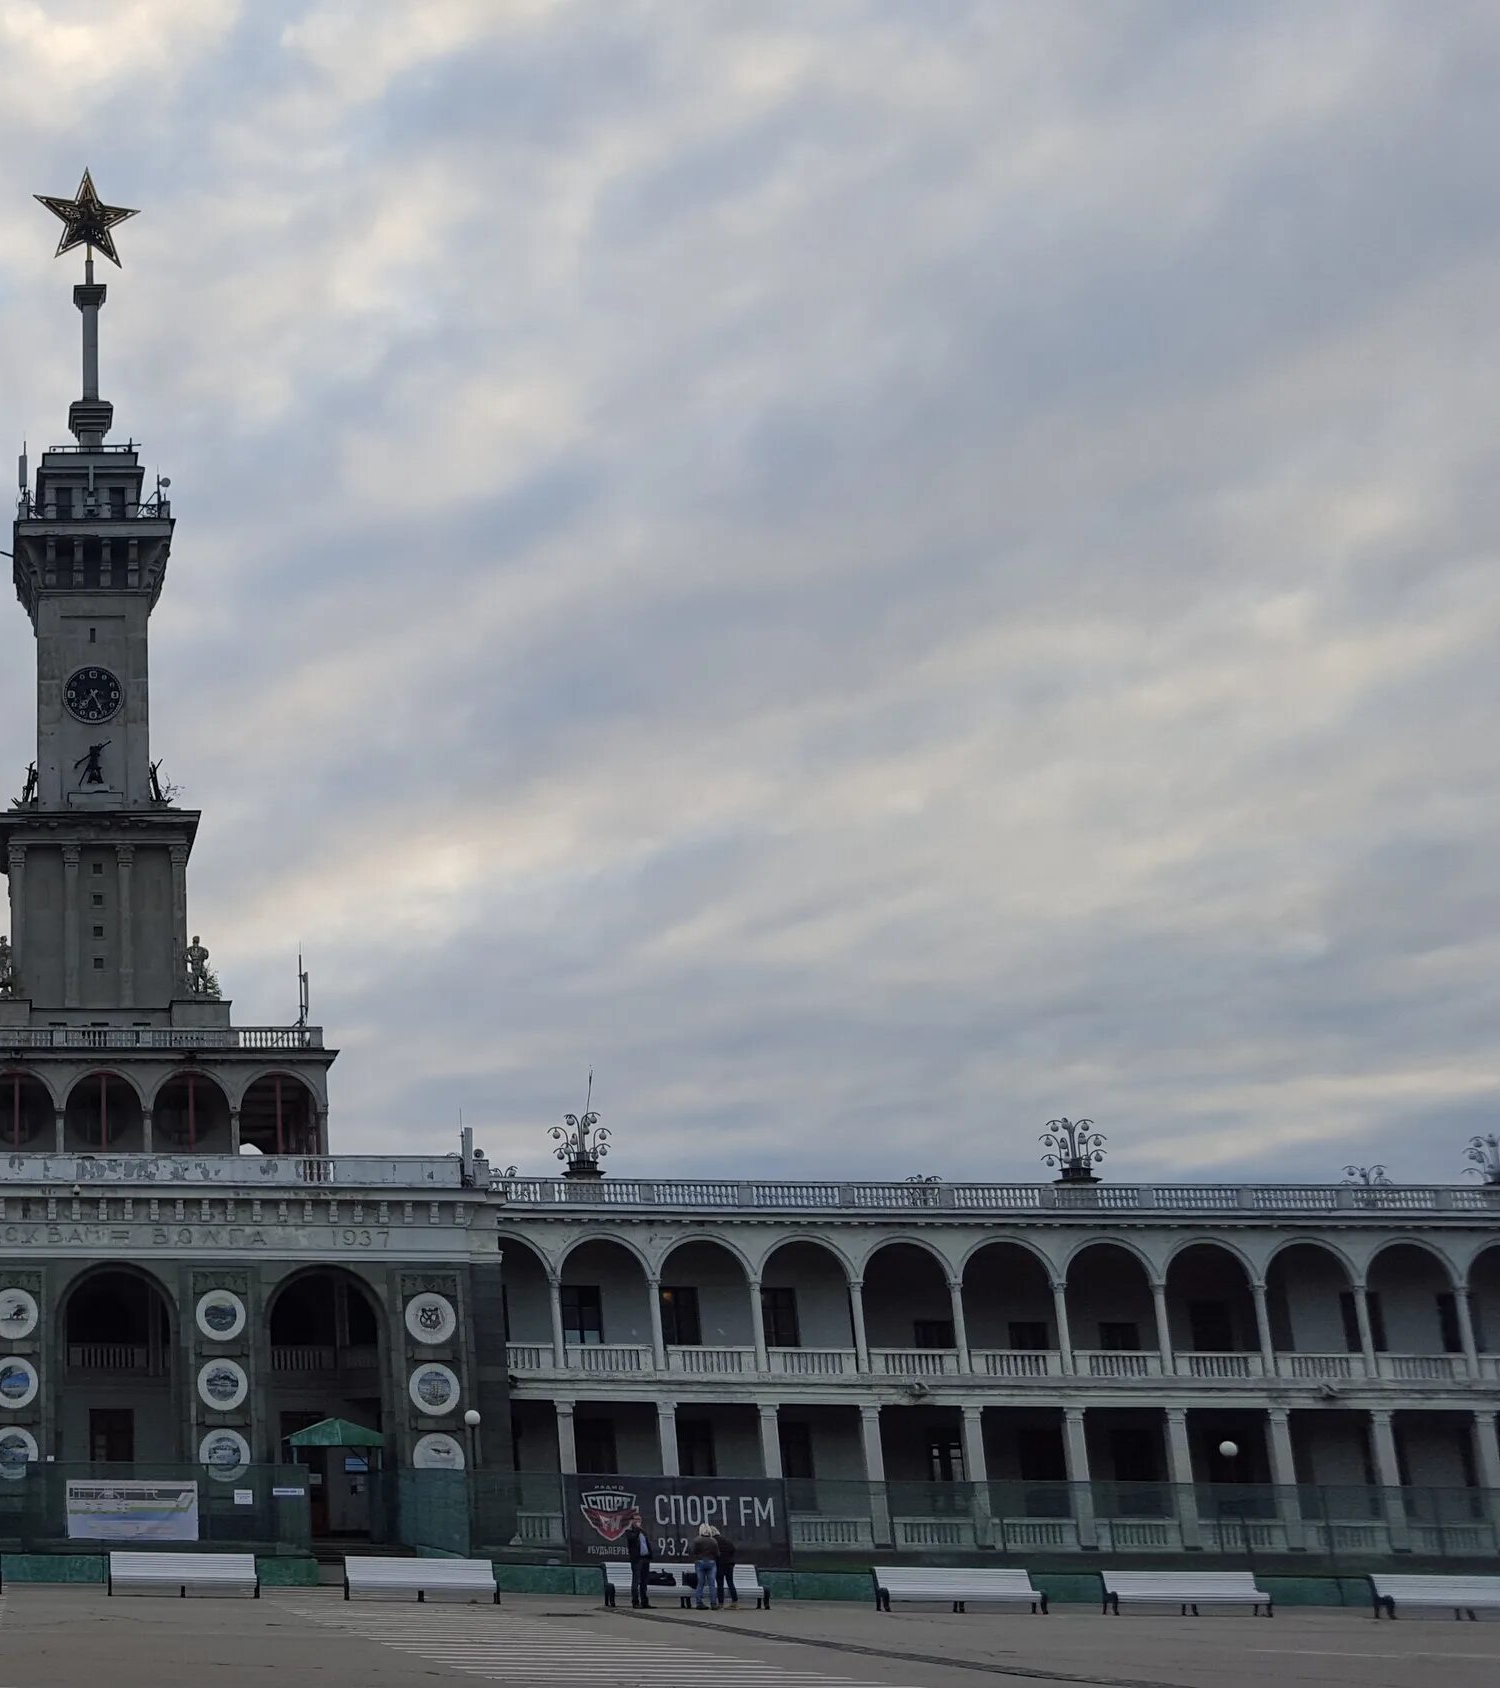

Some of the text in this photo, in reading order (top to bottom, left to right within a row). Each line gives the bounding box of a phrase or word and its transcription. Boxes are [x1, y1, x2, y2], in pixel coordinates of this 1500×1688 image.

[332, 1229, 389, 1248] 1937
[587, 1495, 631, 1511] СПОРТ
[654, 1494, 775, 1527] СПОРТ FM
[658, 1537, 690, 1556] 93.2
